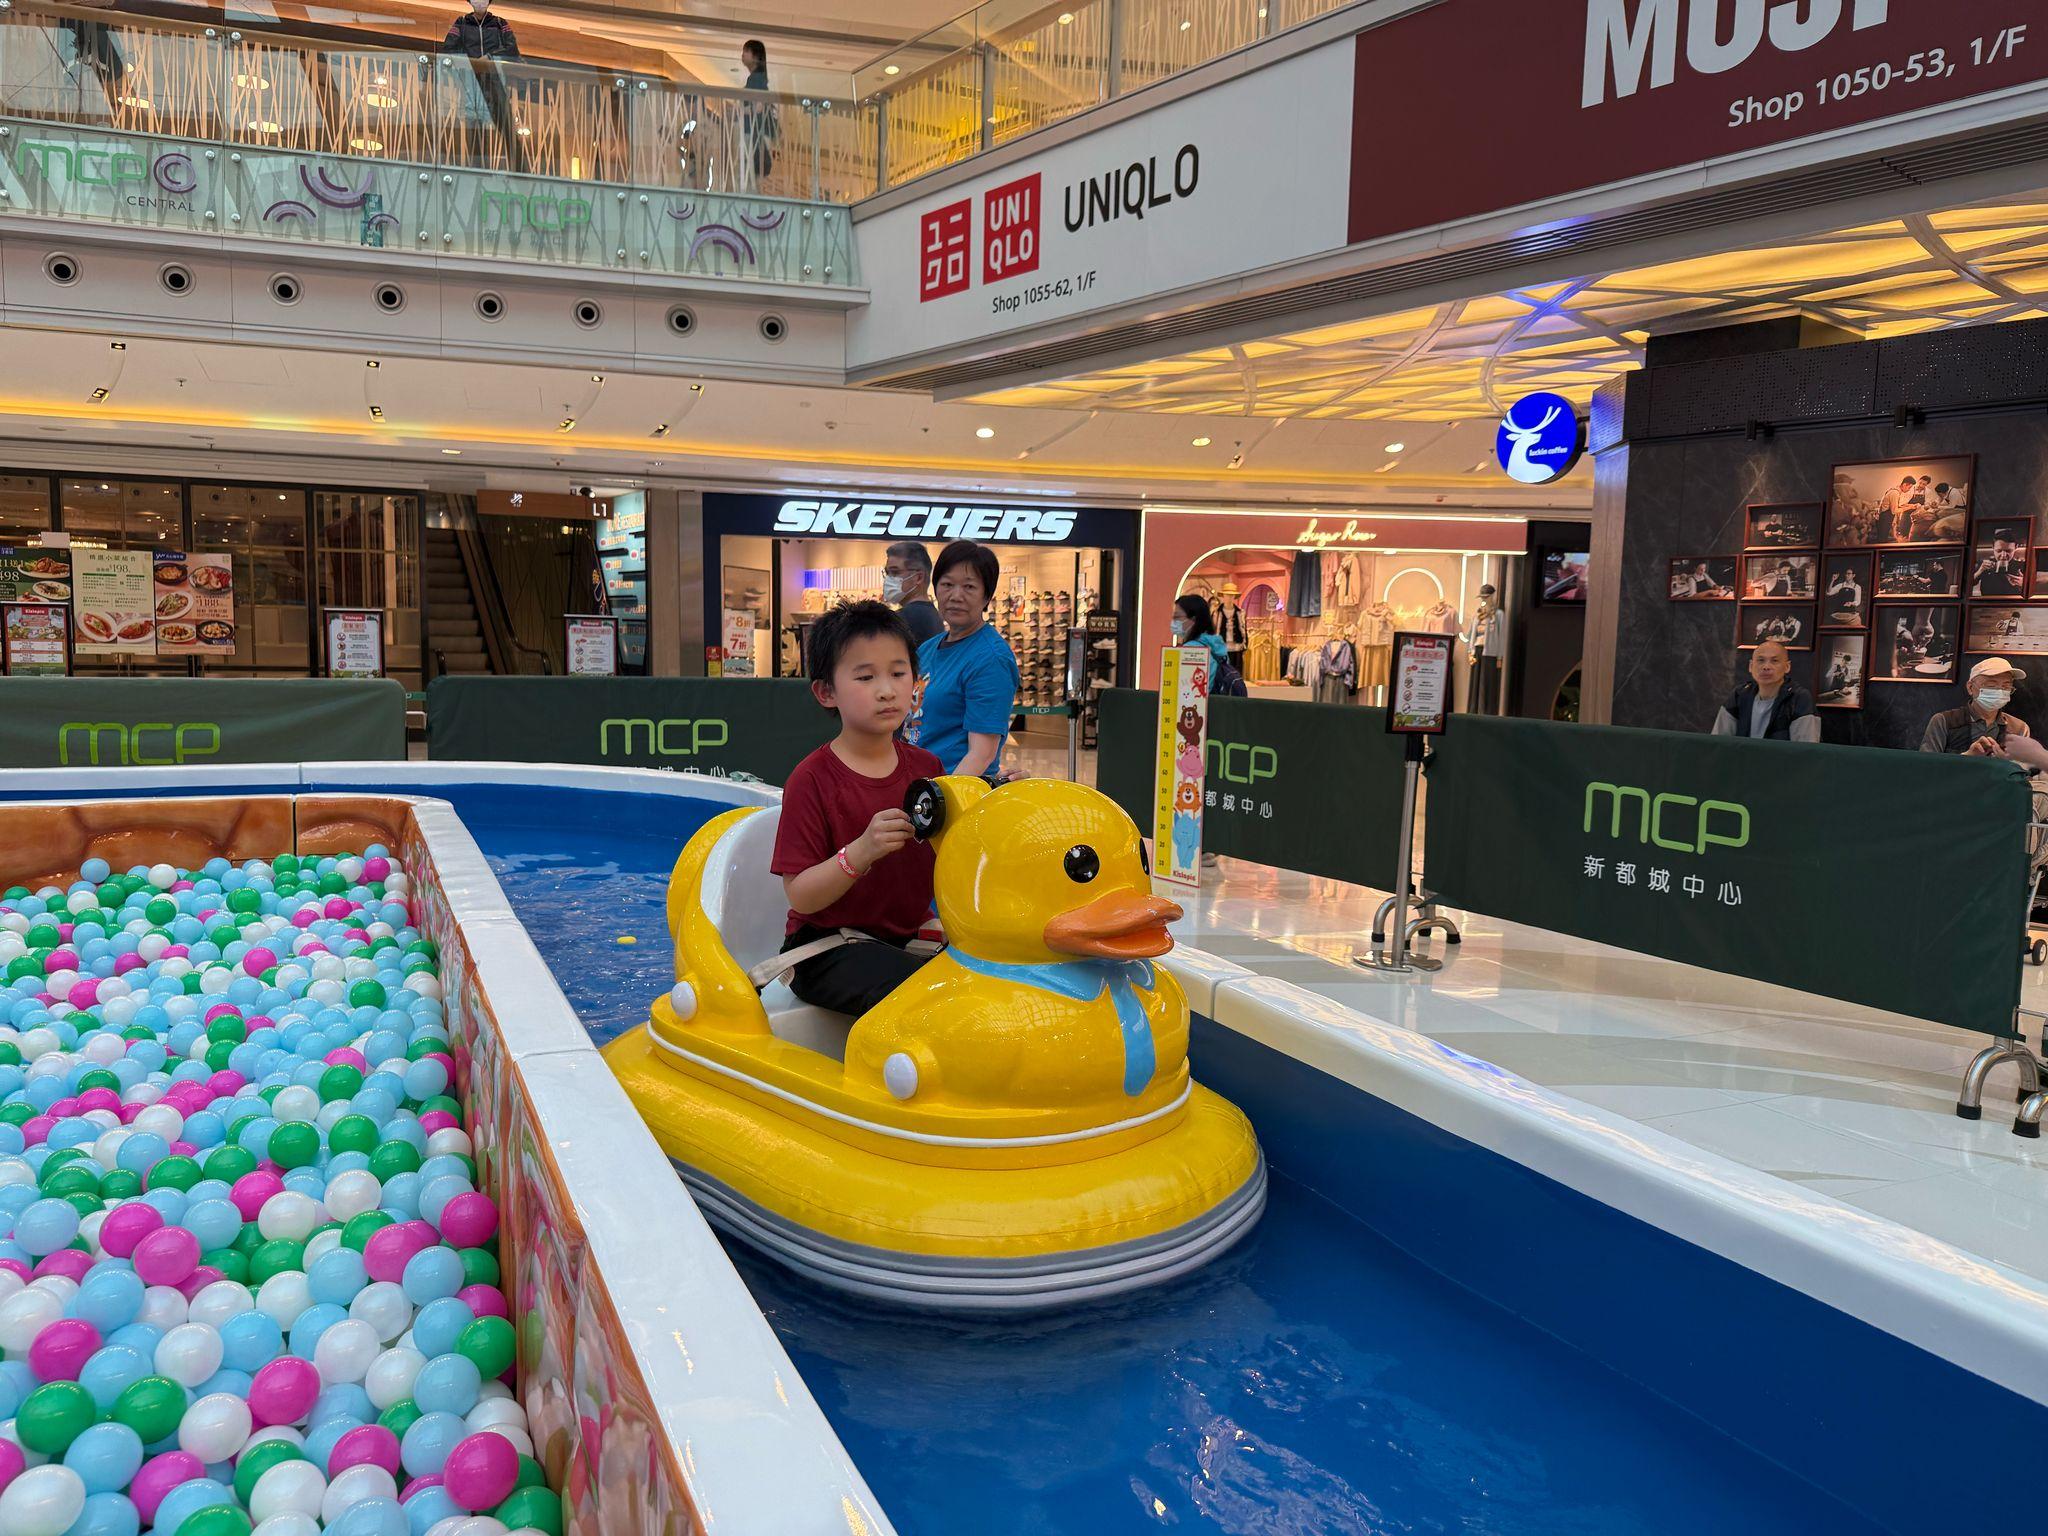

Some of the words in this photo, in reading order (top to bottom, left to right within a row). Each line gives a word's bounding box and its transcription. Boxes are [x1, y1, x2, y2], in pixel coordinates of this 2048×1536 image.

[1728, 90, 1804, 128] Shop
[1815, 47, 1955, 105] 1050-53,
[1970, 25, 2027, 68] 1/F
[126, 195, 196, 213] CENTRAL
[990, 188, 1031, 232] UNI
[1063, 143, 1200, 233] UNIQLO
[988, 228, 1034, 274] QLO
[992, 291, 1021, 314] Shop
[1023, 280, 1074, 306] 1055-62,
[1076, 270, 1097, 293] 1/F
[592, 502, 607, 518] L1
[772, 500, 1079, 542] SKECHERS
[1583, 854, 1743, 907] 新都城中心
